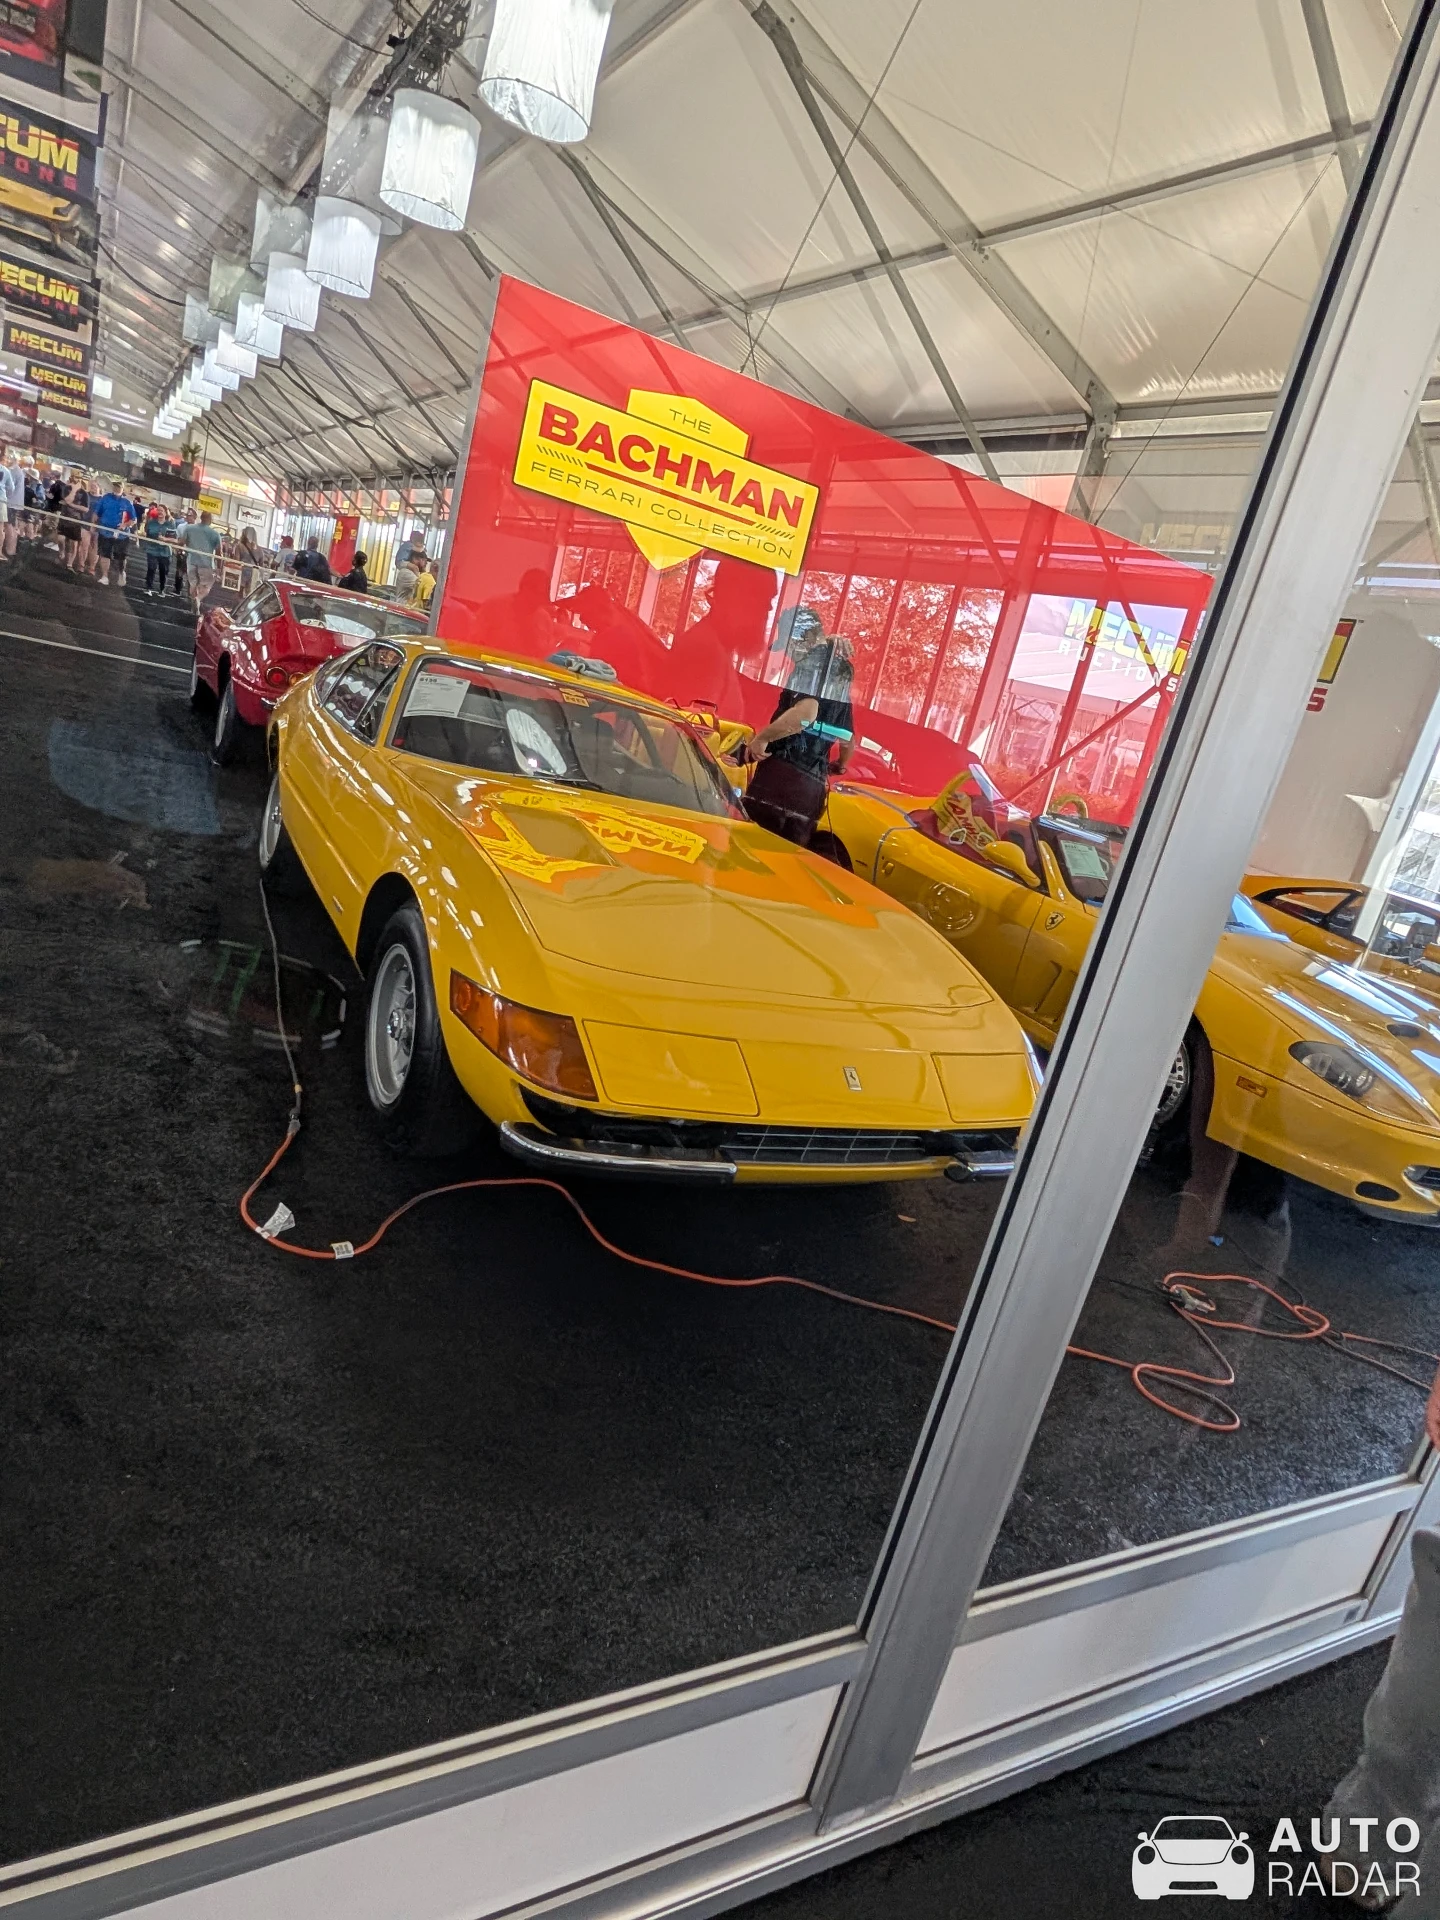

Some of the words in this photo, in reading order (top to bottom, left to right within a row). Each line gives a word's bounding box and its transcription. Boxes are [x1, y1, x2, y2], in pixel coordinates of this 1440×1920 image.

[0, 113, 79, 175] UM
[0, 261, 79, 306] ECUM
[10, 327, 83, 362] MECUM
[31, 366, 87, 392] MECUM
[41, 390, 88, 411] MECUM
[669, 408, 712, 434] THE
[538, 402, 804, 528] BACHMAN
[531, 462, 642, 509] FERRARI
[650, 503, 793, 560] COLLECTION
[1064, 599, 1190, 676] MECUM
[1058, 638, 1178, 693] AUCTIONS
